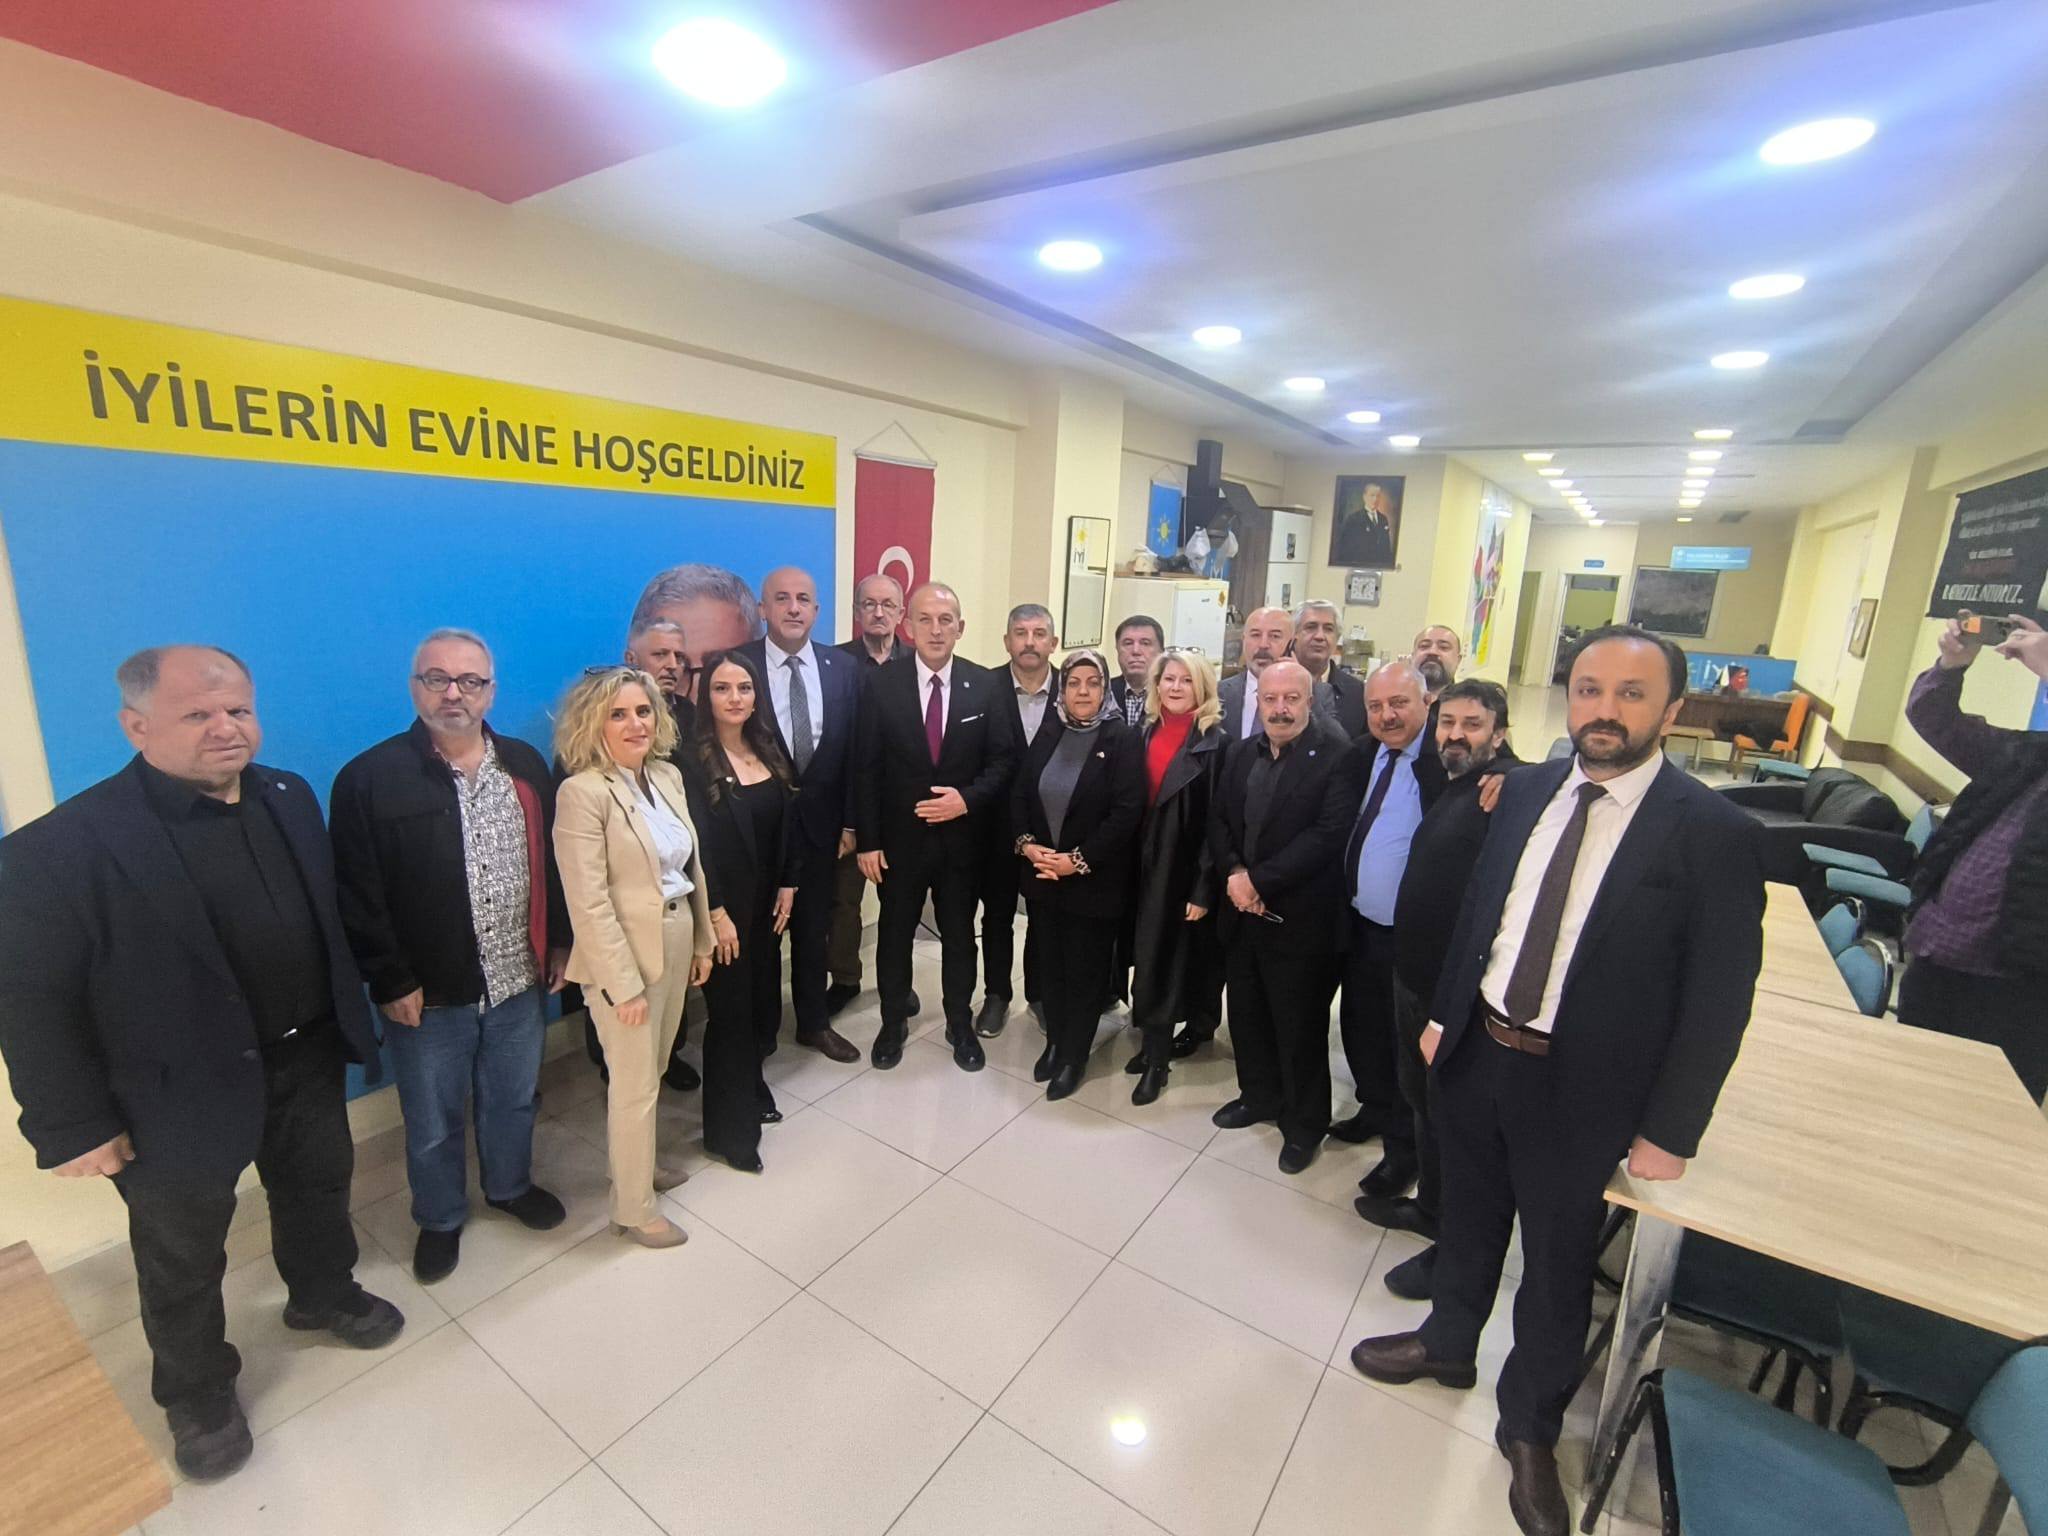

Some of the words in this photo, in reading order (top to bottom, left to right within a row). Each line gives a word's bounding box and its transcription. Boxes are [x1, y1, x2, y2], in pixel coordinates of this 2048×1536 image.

[83, 349, 388, 448] İYİLERİN
[408, 406, 558, 466] EVİNE
[573, 430, 806, 490] HOŞGELDİNİZ
